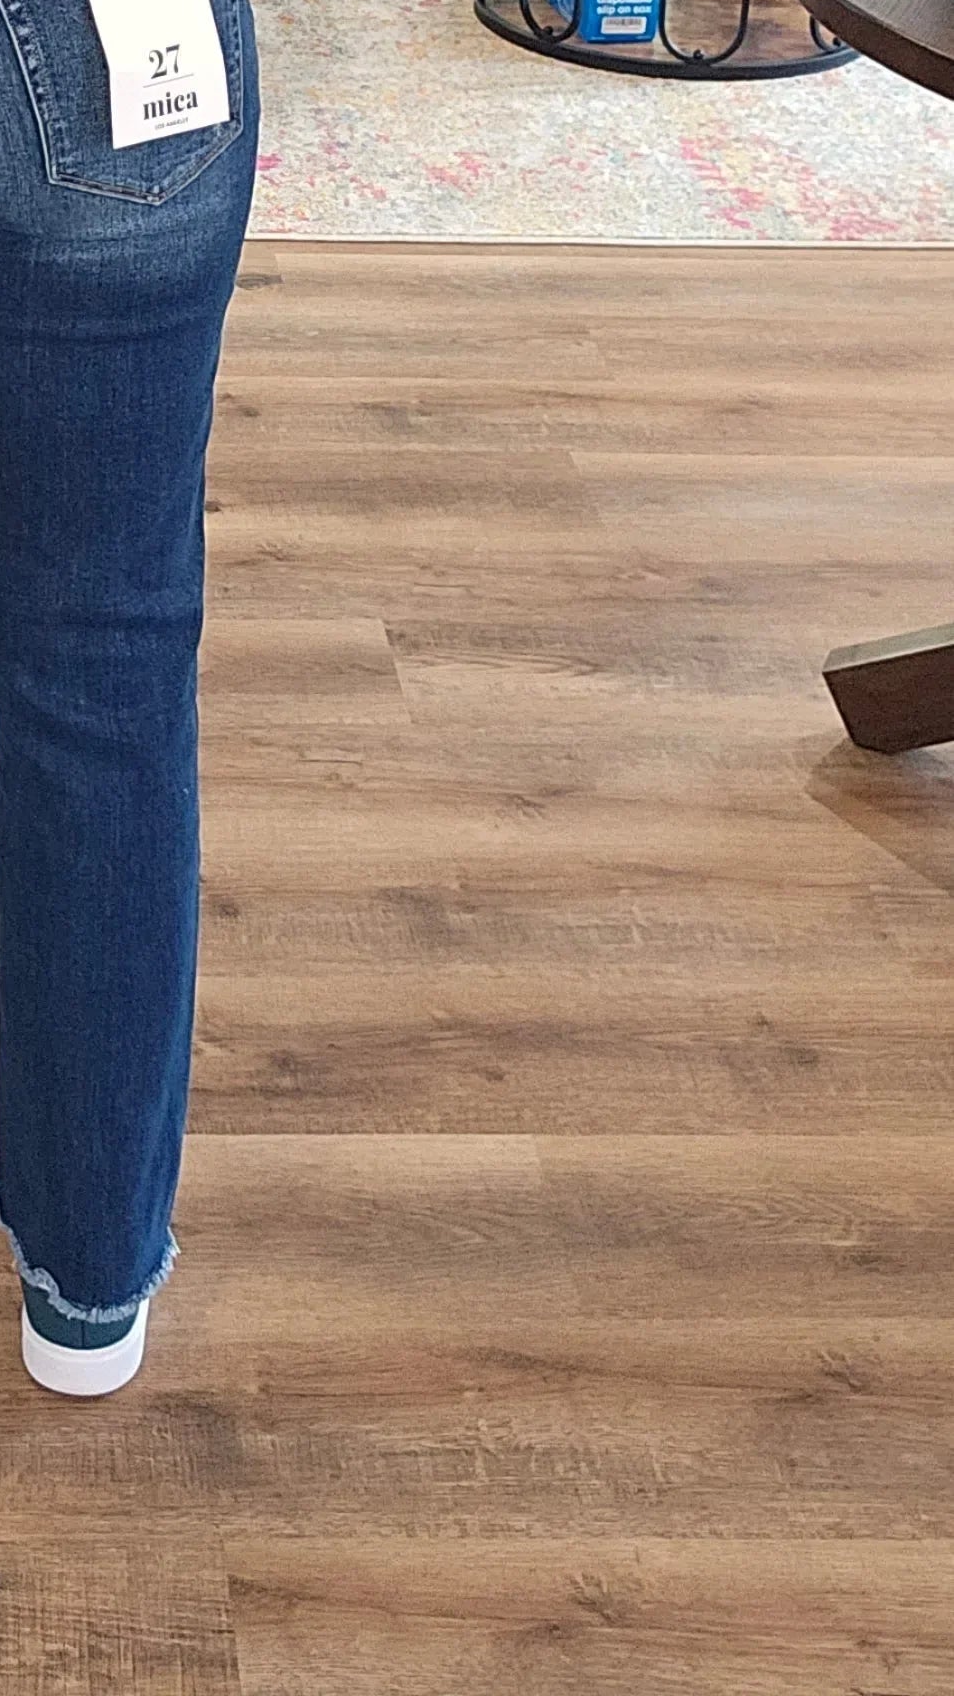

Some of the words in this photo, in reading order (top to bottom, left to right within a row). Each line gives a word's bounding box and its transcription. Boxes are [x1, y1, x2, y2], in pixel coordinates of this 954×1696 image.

[596, 5, 616, 15] slip
[617, 6, 632, 14] on
[148, 44, 181, 80] 27
[142, 91, 199, 121] mica
